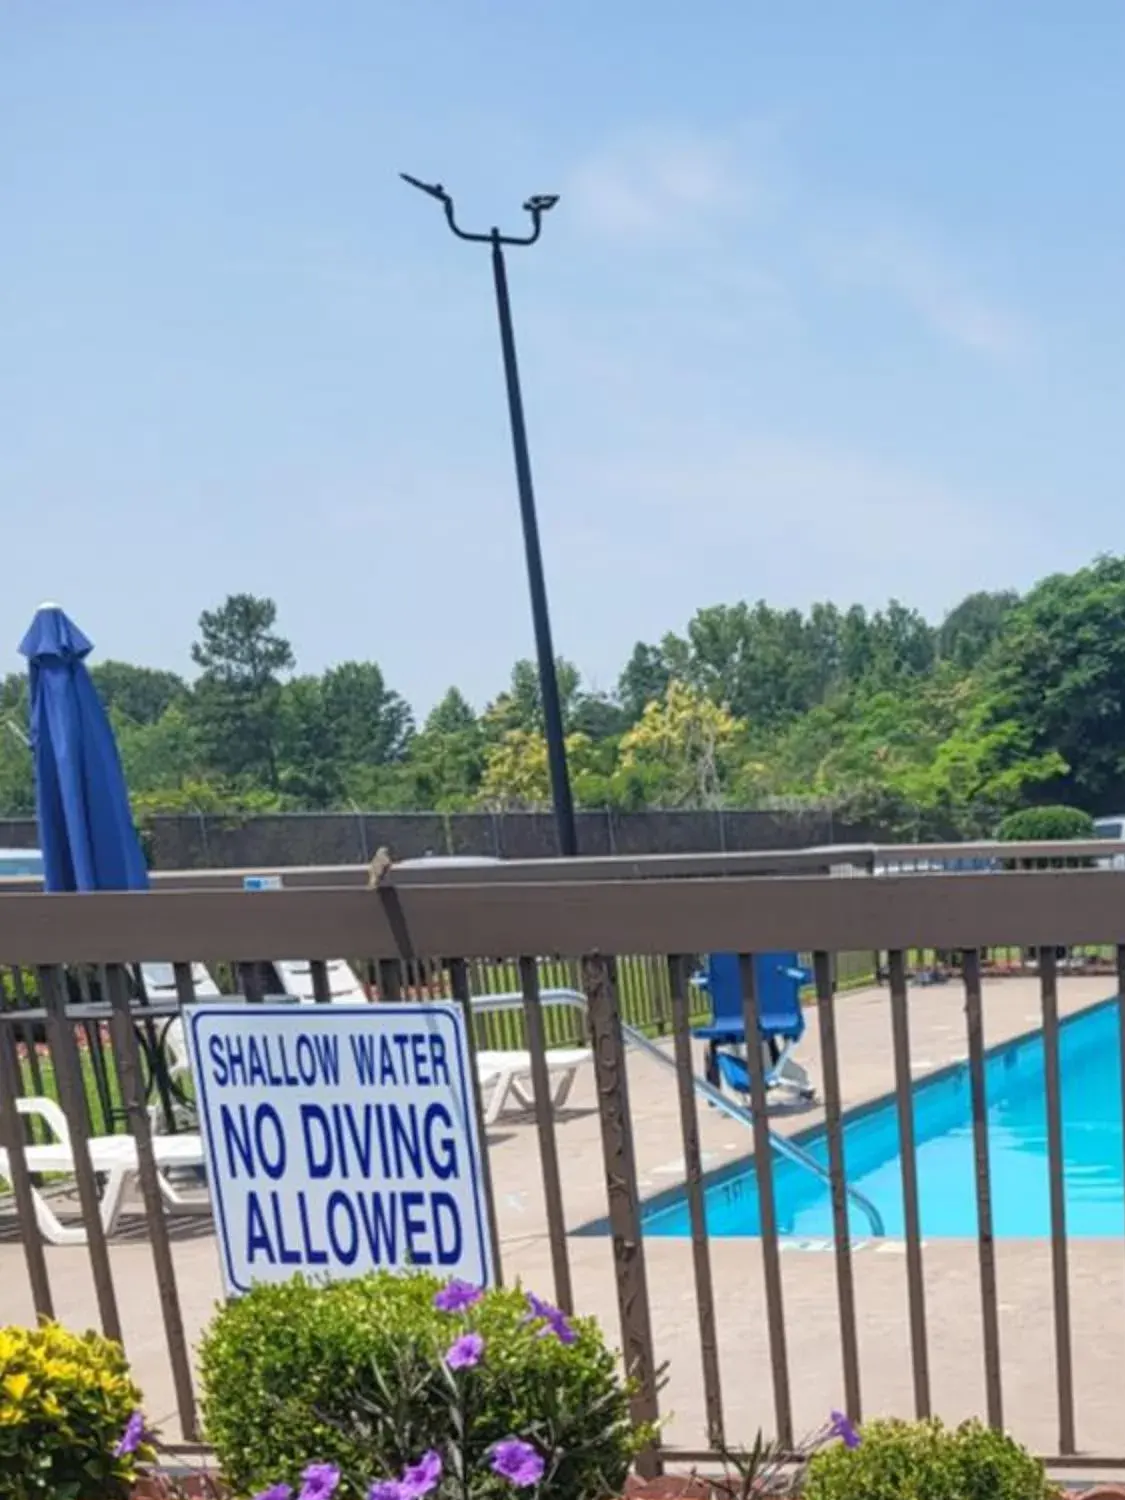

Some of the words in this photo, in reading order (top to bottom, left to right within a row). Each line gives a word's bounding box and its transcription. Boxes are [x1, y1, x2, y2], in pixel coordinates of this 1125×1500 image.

[209, 1034, 339, 1086] SHALLOW
[350, 1034, 449, 1086] WATER
[220, 1102, 287, 1180] NO
[299, 1102, 459, 1180] DIVING
[247, 1190, 462, 1265] ALLOWED
